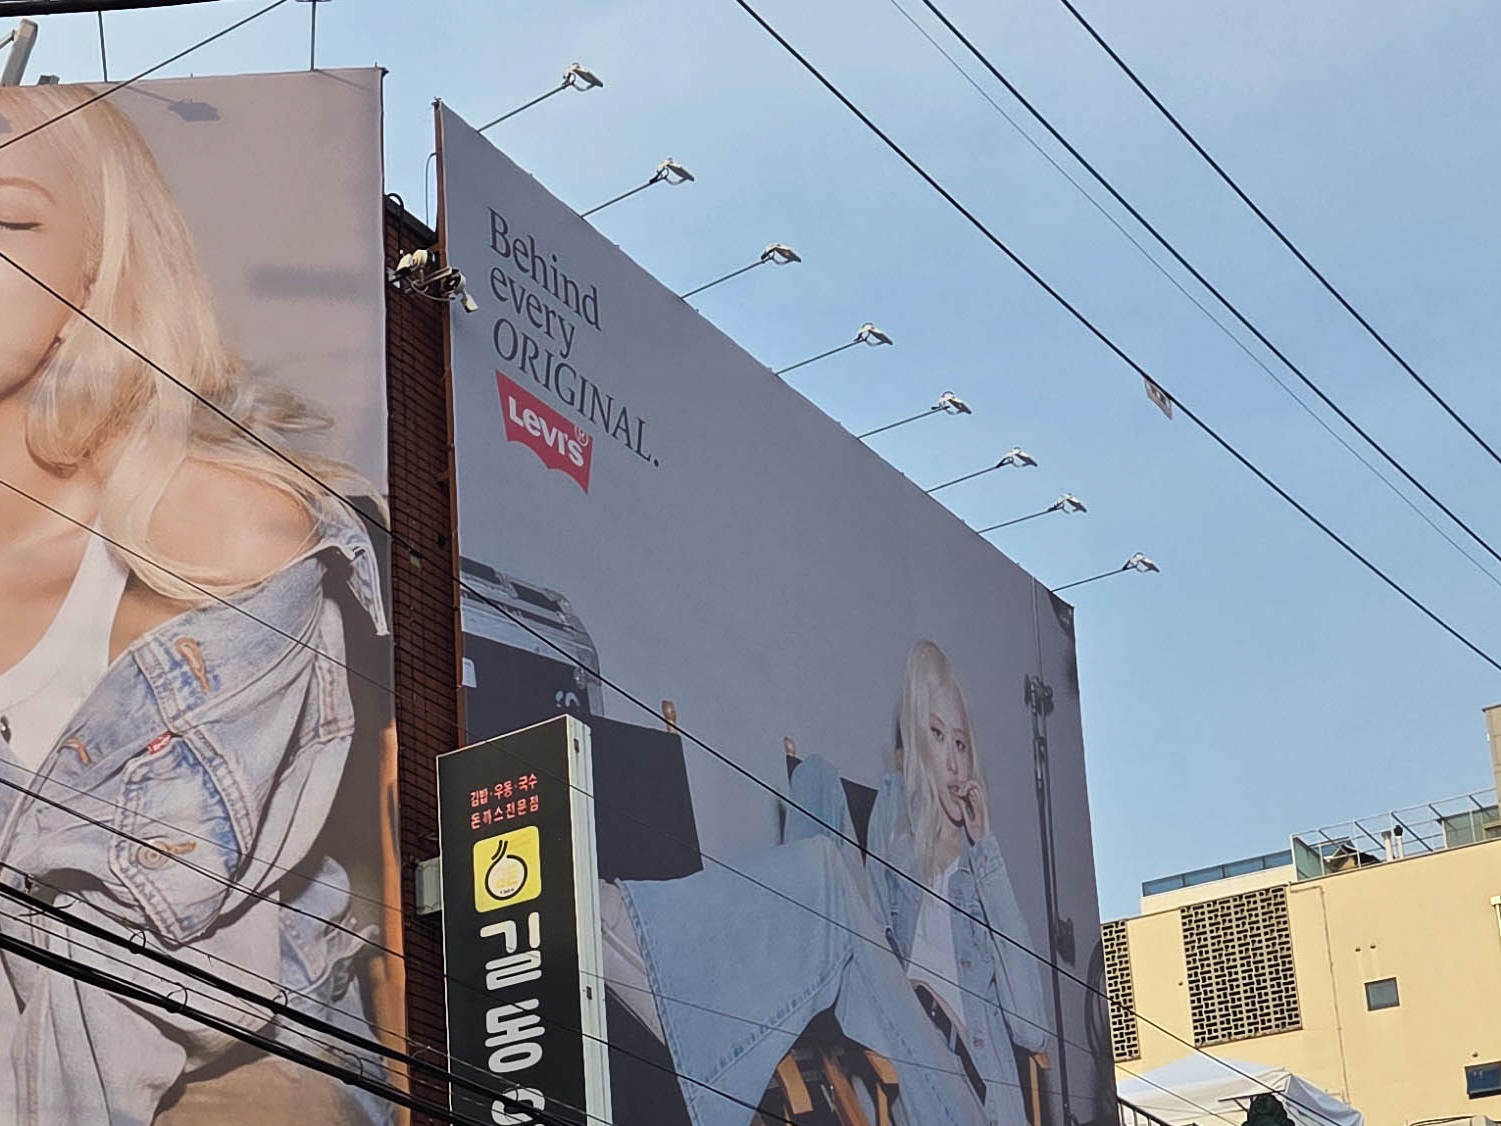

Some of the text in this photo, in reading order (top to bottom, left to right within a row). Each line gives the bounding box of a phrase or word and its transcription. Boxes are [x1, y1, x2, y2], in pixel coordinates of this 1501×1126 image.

[487, 206, 602, 331] Behind
[489, 266, 575, 359] every
[493, 318, 659, 467] ORIGINAL.
